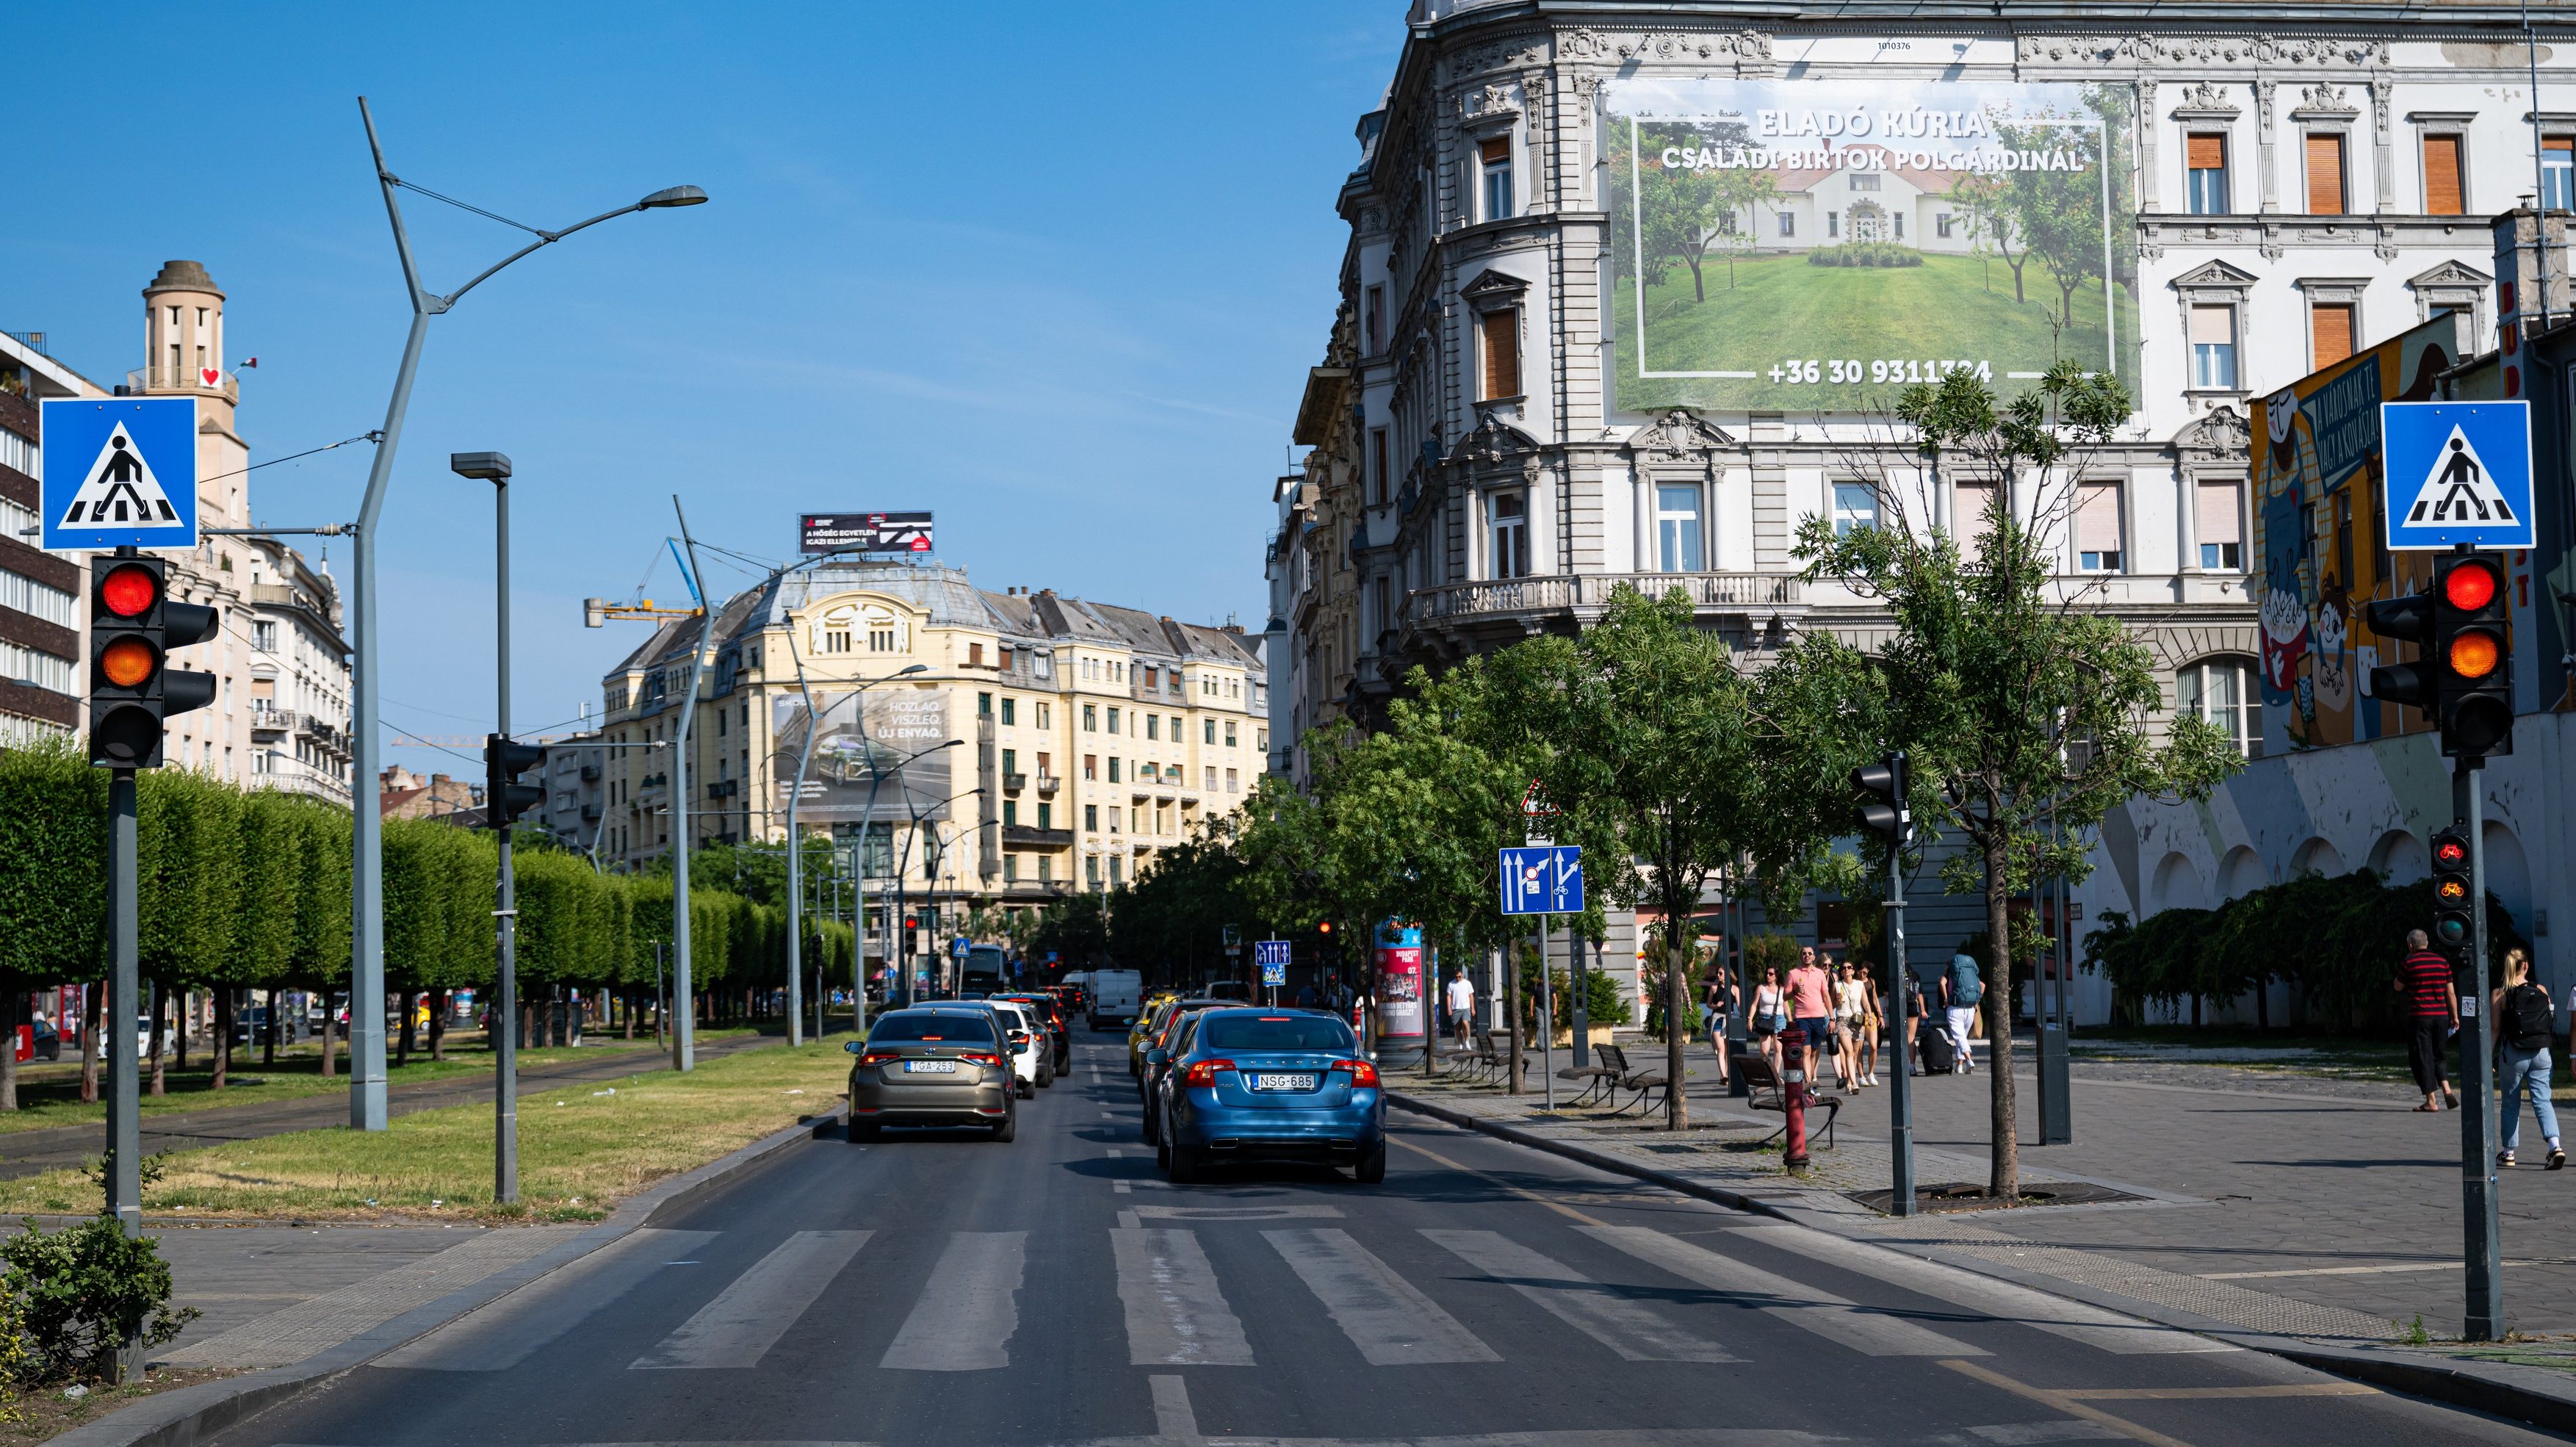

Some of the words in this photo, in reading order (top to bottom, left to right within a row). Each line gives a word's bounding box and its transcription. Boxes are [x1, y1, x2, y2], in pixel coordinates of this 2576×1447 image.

[1877, 42, 1911, 50] 1010376
[1757, 106, 1872, 139] ELADÓ
[1885, 106, 1988, 140] KÚRIA
[1661, 147, 1781, 170] CSALÁDI
[1786, 149, 1887, 171] BIRTOK
[1894, 147, 2085, 173] POLGÁRDINÁL
[1767, 360, 1822, 384] +36
[1828, 360, 1864, 384] 30
[2317, 393, 2325, 433] A
[2323, 372, 2364, 429] VÁROSNAK
[2364, 362, 2376, 403] TE
[2317, 432, 2337, 474] VAGY
[2338, 435, 2344, 464] A
[2342, 405, 2380, 461] KOVÁSZA!
[892, 714, 942, 725] VISZLEQ.
[878, 726, 894, 739] ÚJ
[897, 727, 943, 738] ENYAQ.
[1396, 950, 1419, 958] BUDAPEST
[913, 1062, 953, 1070] TGA-253
[1260, 1075, 1313, 1087] NSG-685
